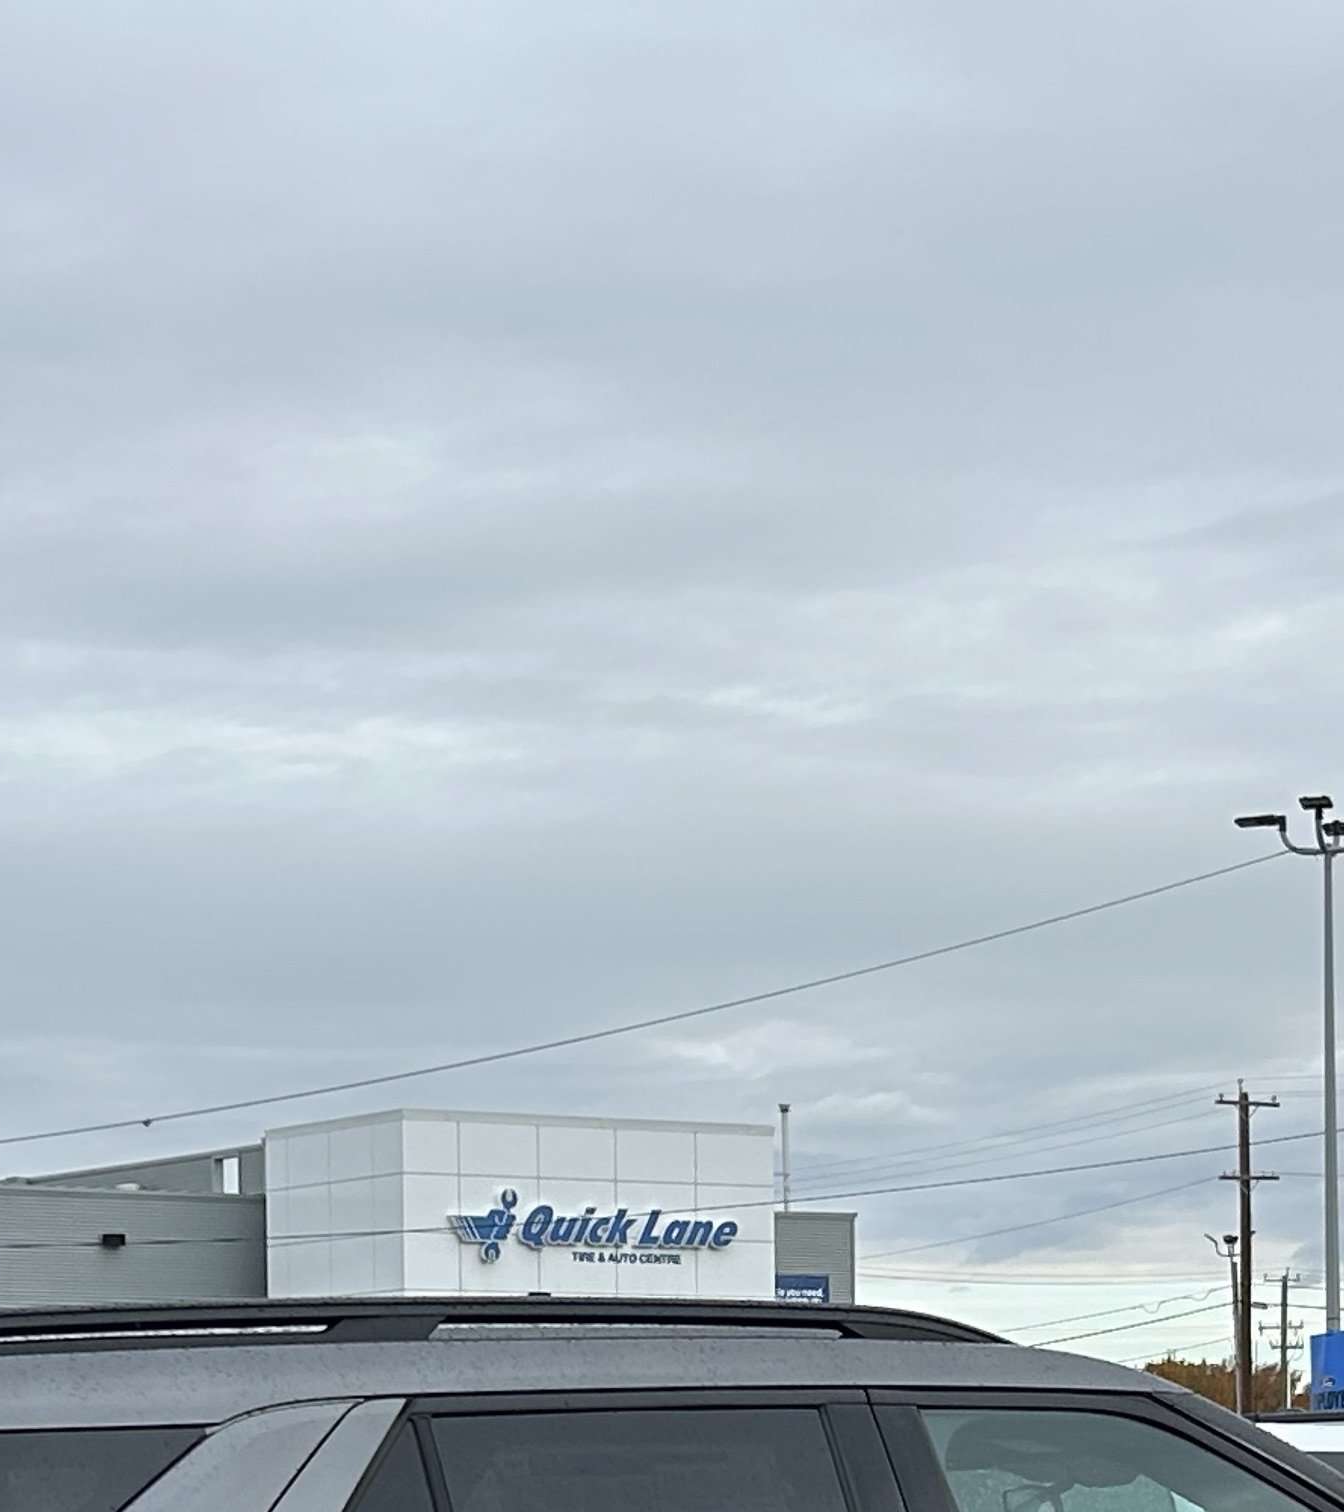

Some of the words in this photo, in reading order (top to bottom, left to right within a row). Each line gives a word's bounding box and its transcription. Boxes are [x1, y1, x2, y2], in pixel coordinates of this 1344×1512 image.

[522, 1205, 635, 1247] Quick
[639, 1209, 738, 1248] Lane
[572, 1252, 595, 1263] TIRE
[598, 1253, 605, 1263] &
[607, 1253, 637, 1264] AUTO
[639, 1254, 681, 1265] CENTRE
